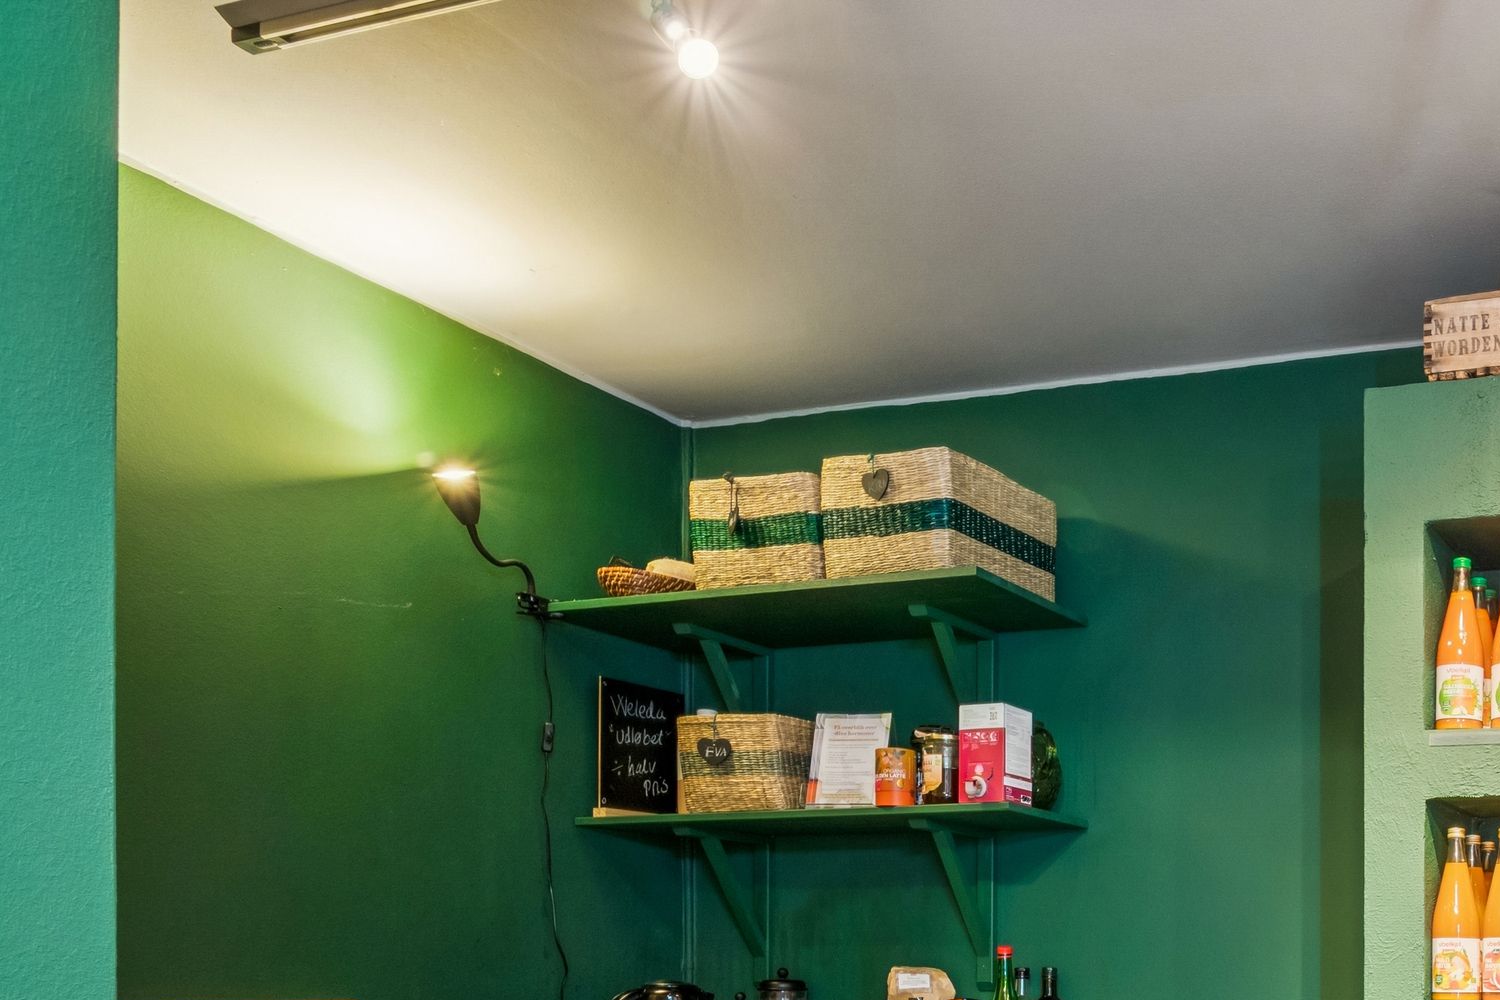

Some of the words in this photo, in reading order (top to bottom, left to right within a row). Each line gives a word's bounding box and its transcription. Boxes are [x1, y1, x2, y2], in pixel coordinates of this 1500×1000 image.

[1434, 312, 1490, 336] NATTE
[610, 694, 667, 720] Weleda
[705, 745, 727, 758] EVA
[628, 754, 657, 777] halv
